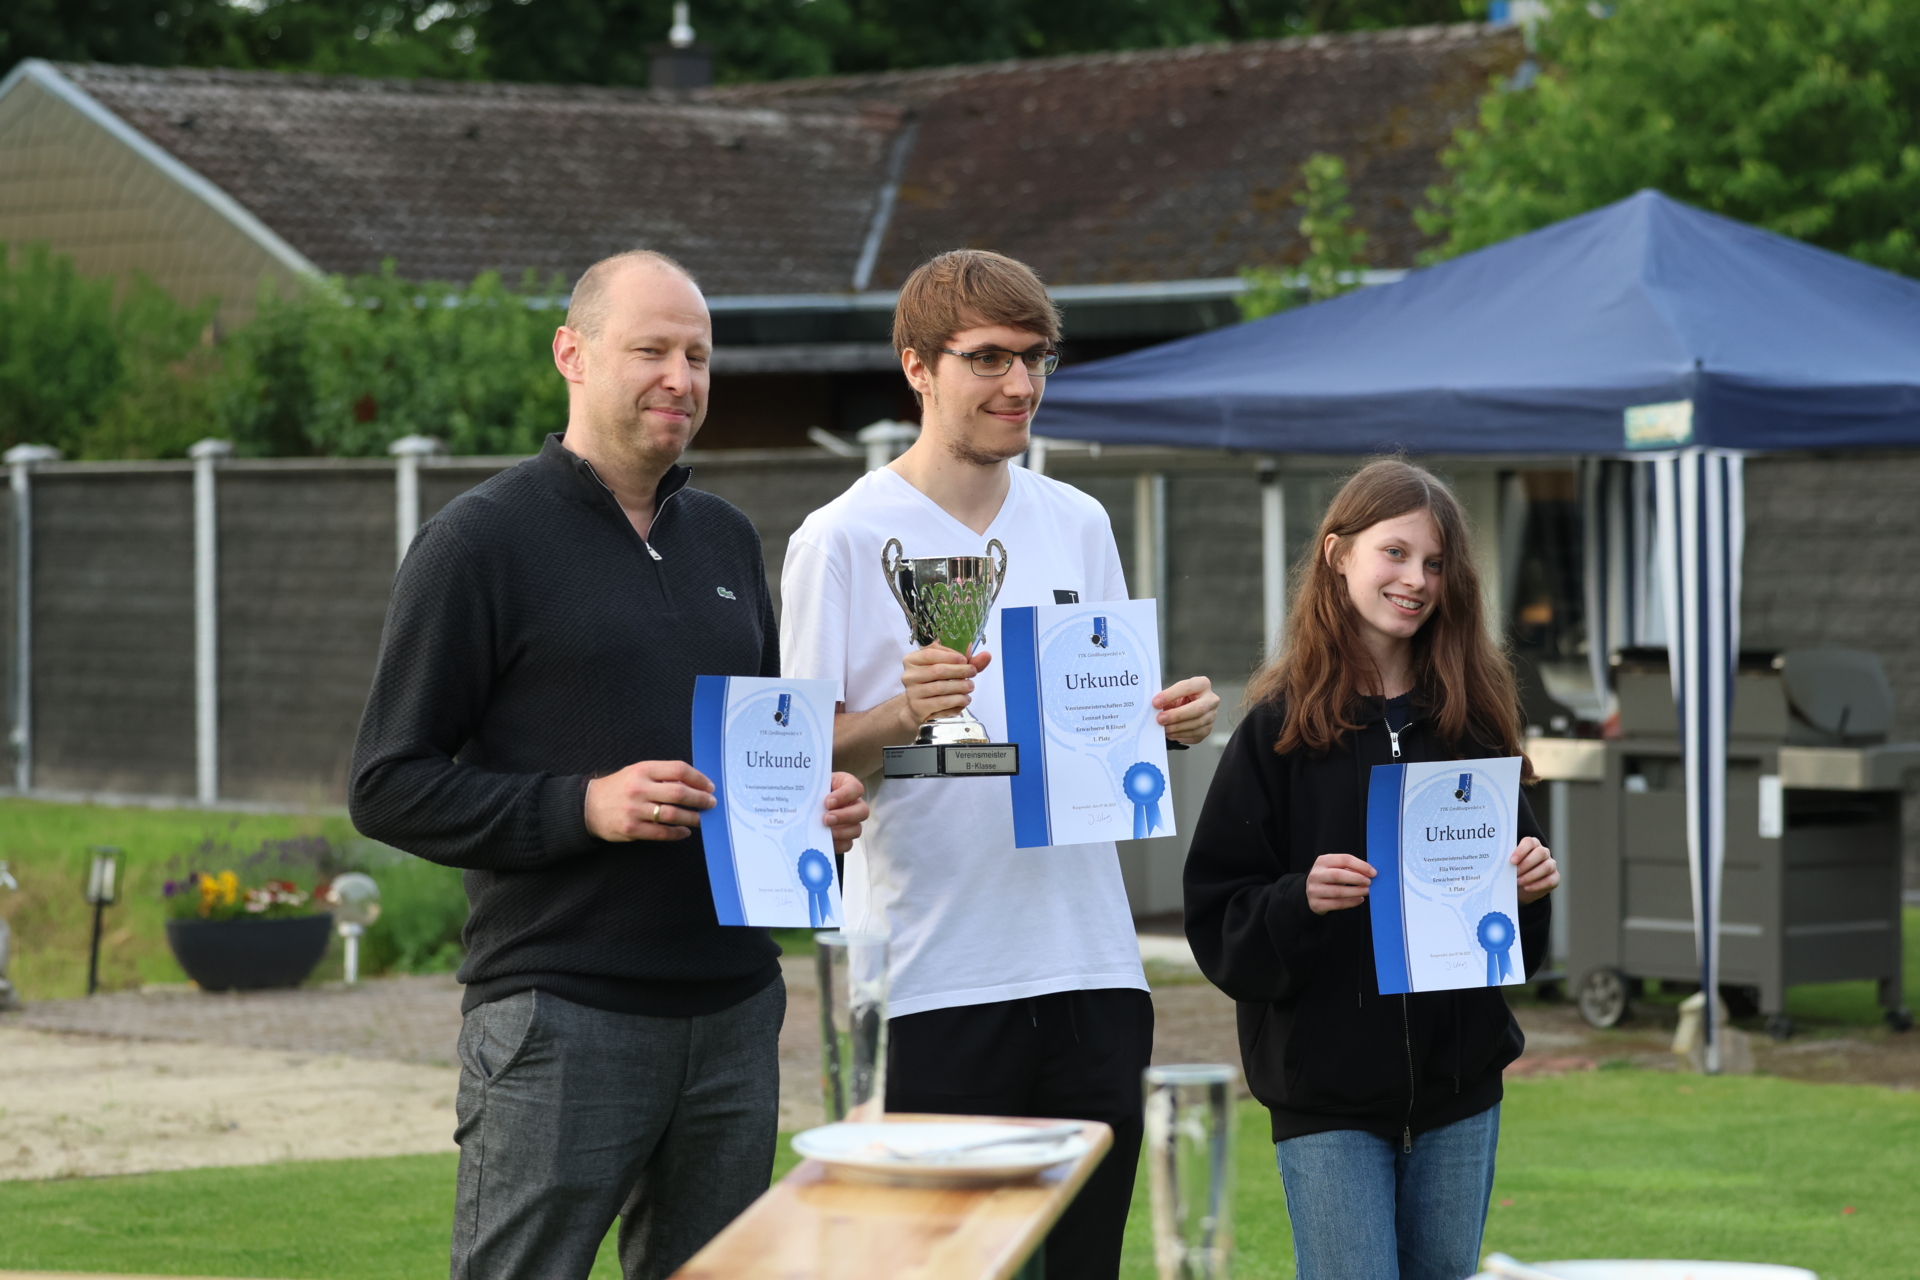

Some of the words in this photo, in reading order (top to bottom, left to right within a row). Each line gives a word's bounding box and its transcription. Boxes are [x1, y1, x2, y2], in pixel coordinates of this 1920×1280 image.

[1065, 670, 1139, 690] Urkunde
[1065, 703, 1122, 711] Vereinsmeisterschaften
[746, 751, 811, 768] Urkunde
[1426, 823, 1496, 842] Urkunde
[1423, 854, 1478, 862] Vereinsmeisterschaften
